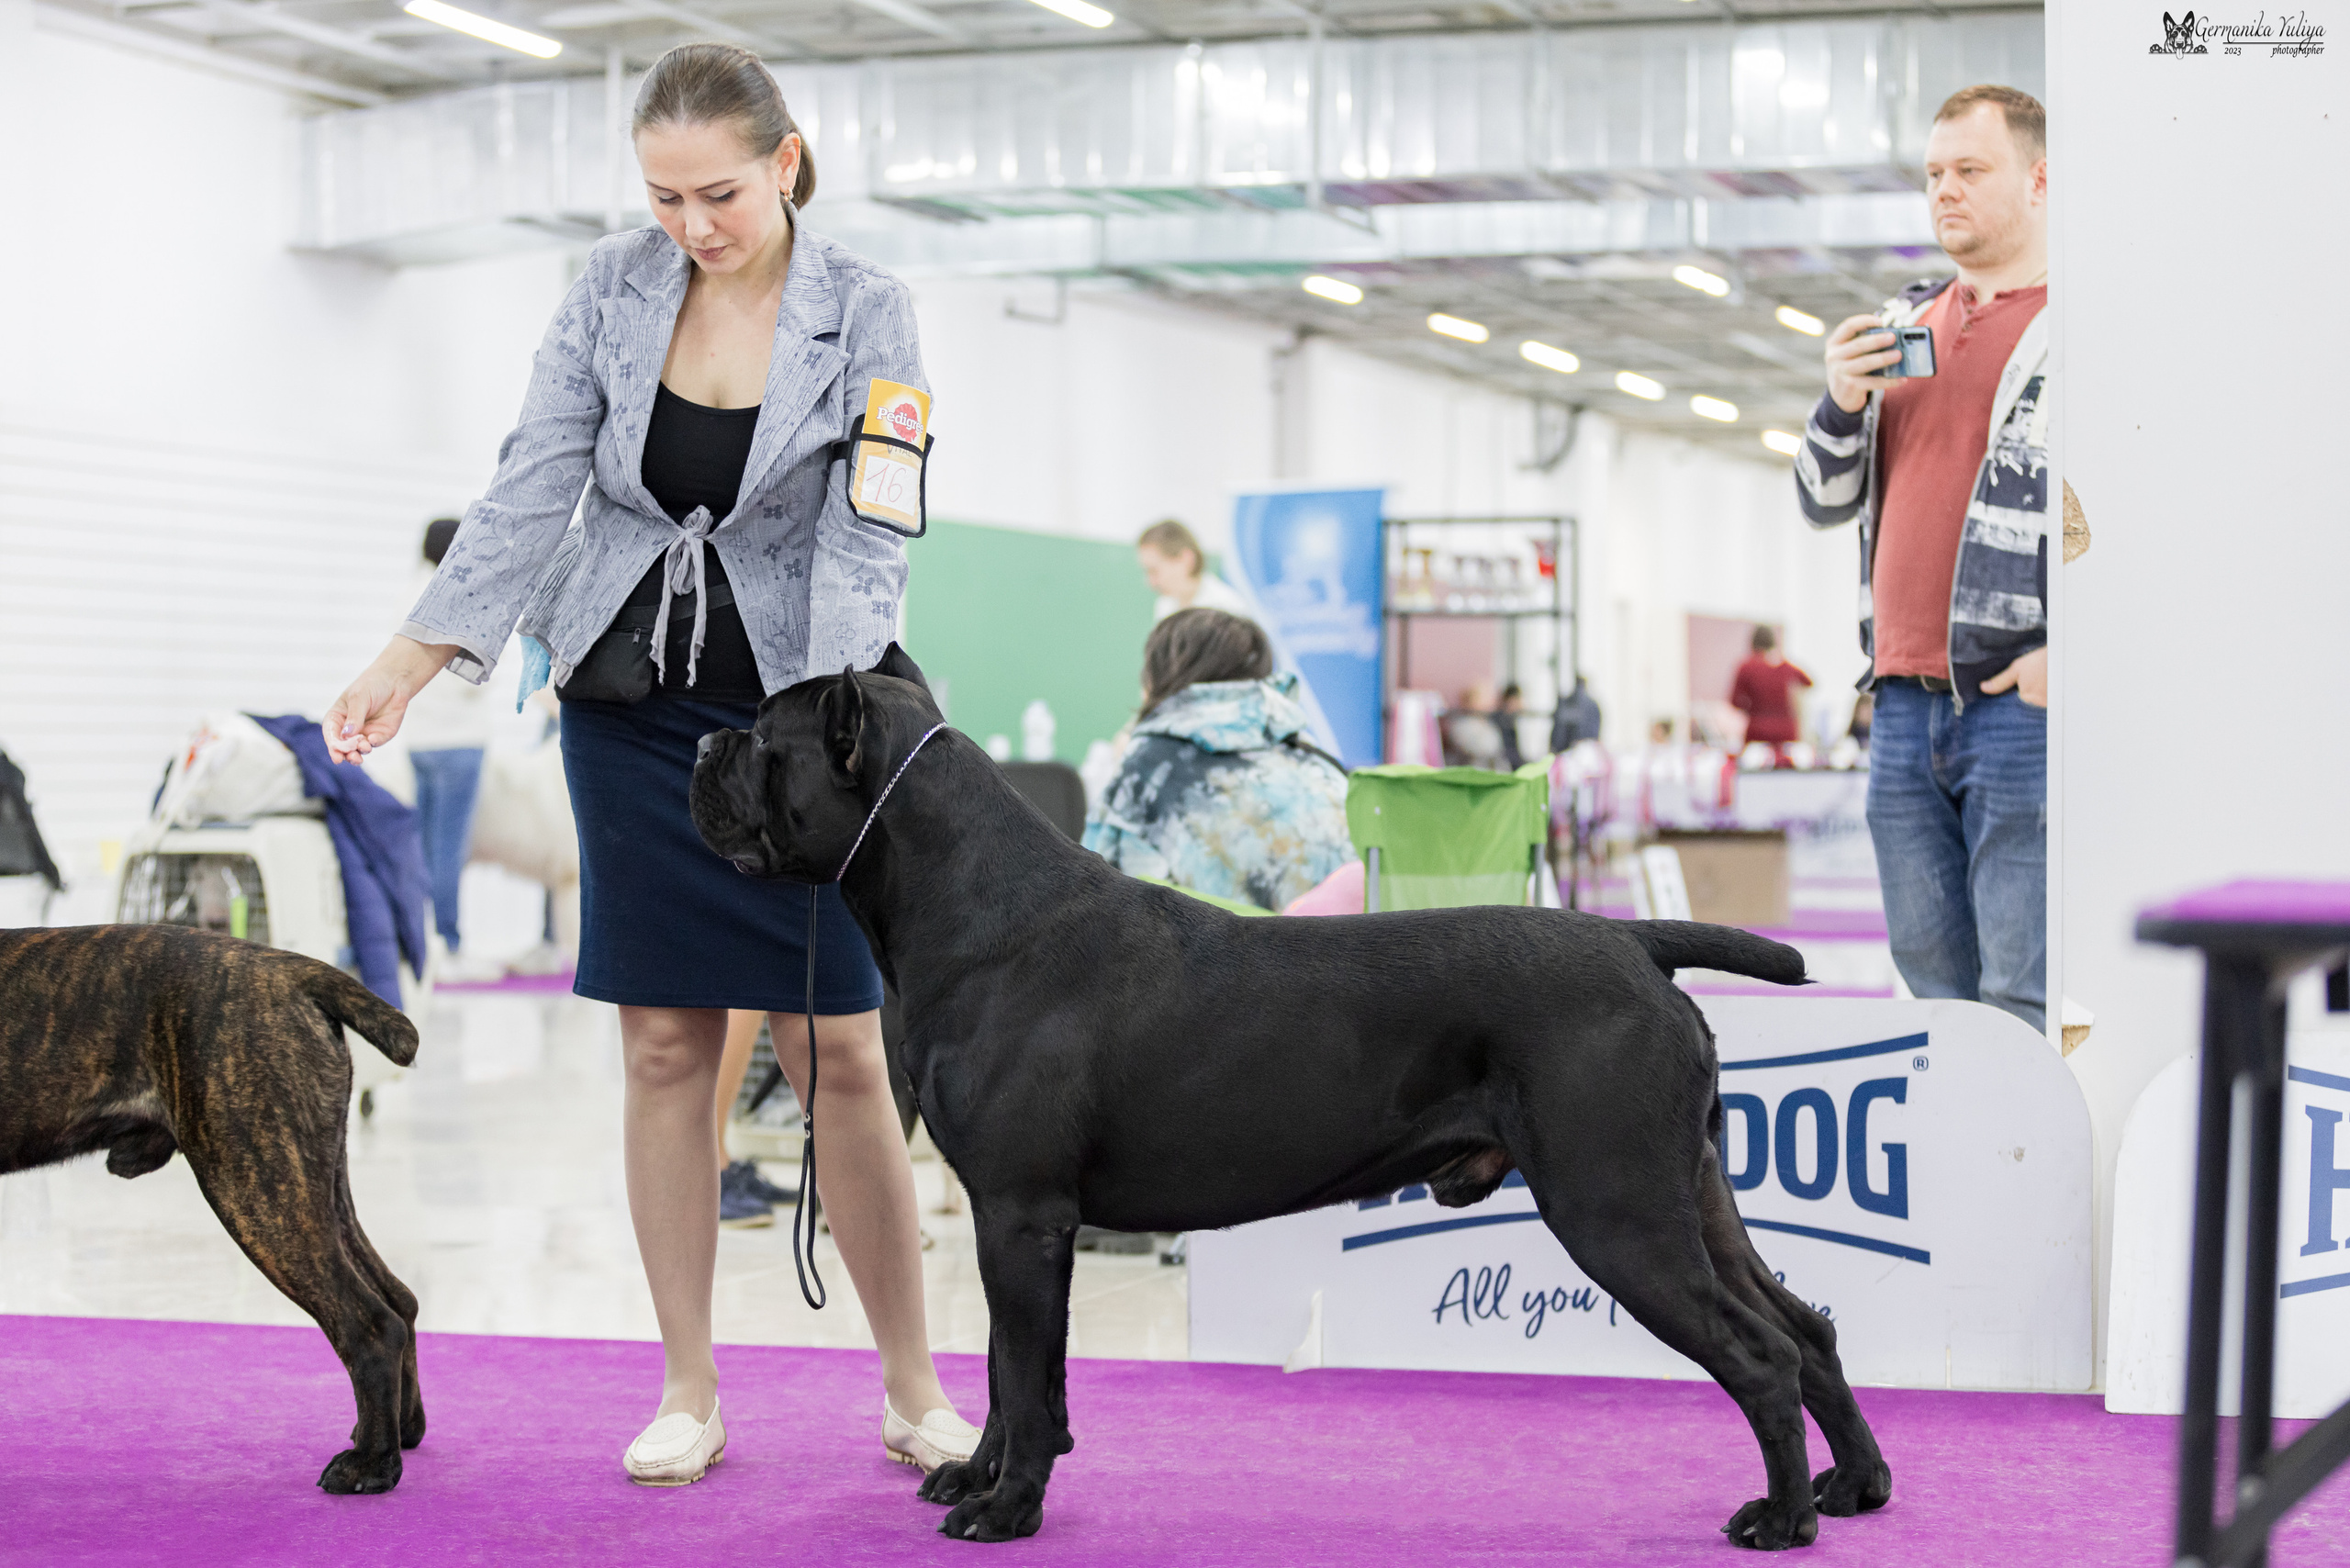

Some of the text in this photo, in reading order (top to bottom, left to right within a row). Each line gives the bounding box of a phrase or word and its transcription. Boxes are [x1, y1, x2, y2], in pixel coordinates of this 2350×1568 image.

[876, 407, 924, 434] Pedigree
[867, 464, 906, 503] 16
[1719, 1077, 1908, 1220] DOG
[1431, 1263, 1511, 1327] All
[1522, 1287, 1599, 1338] you
